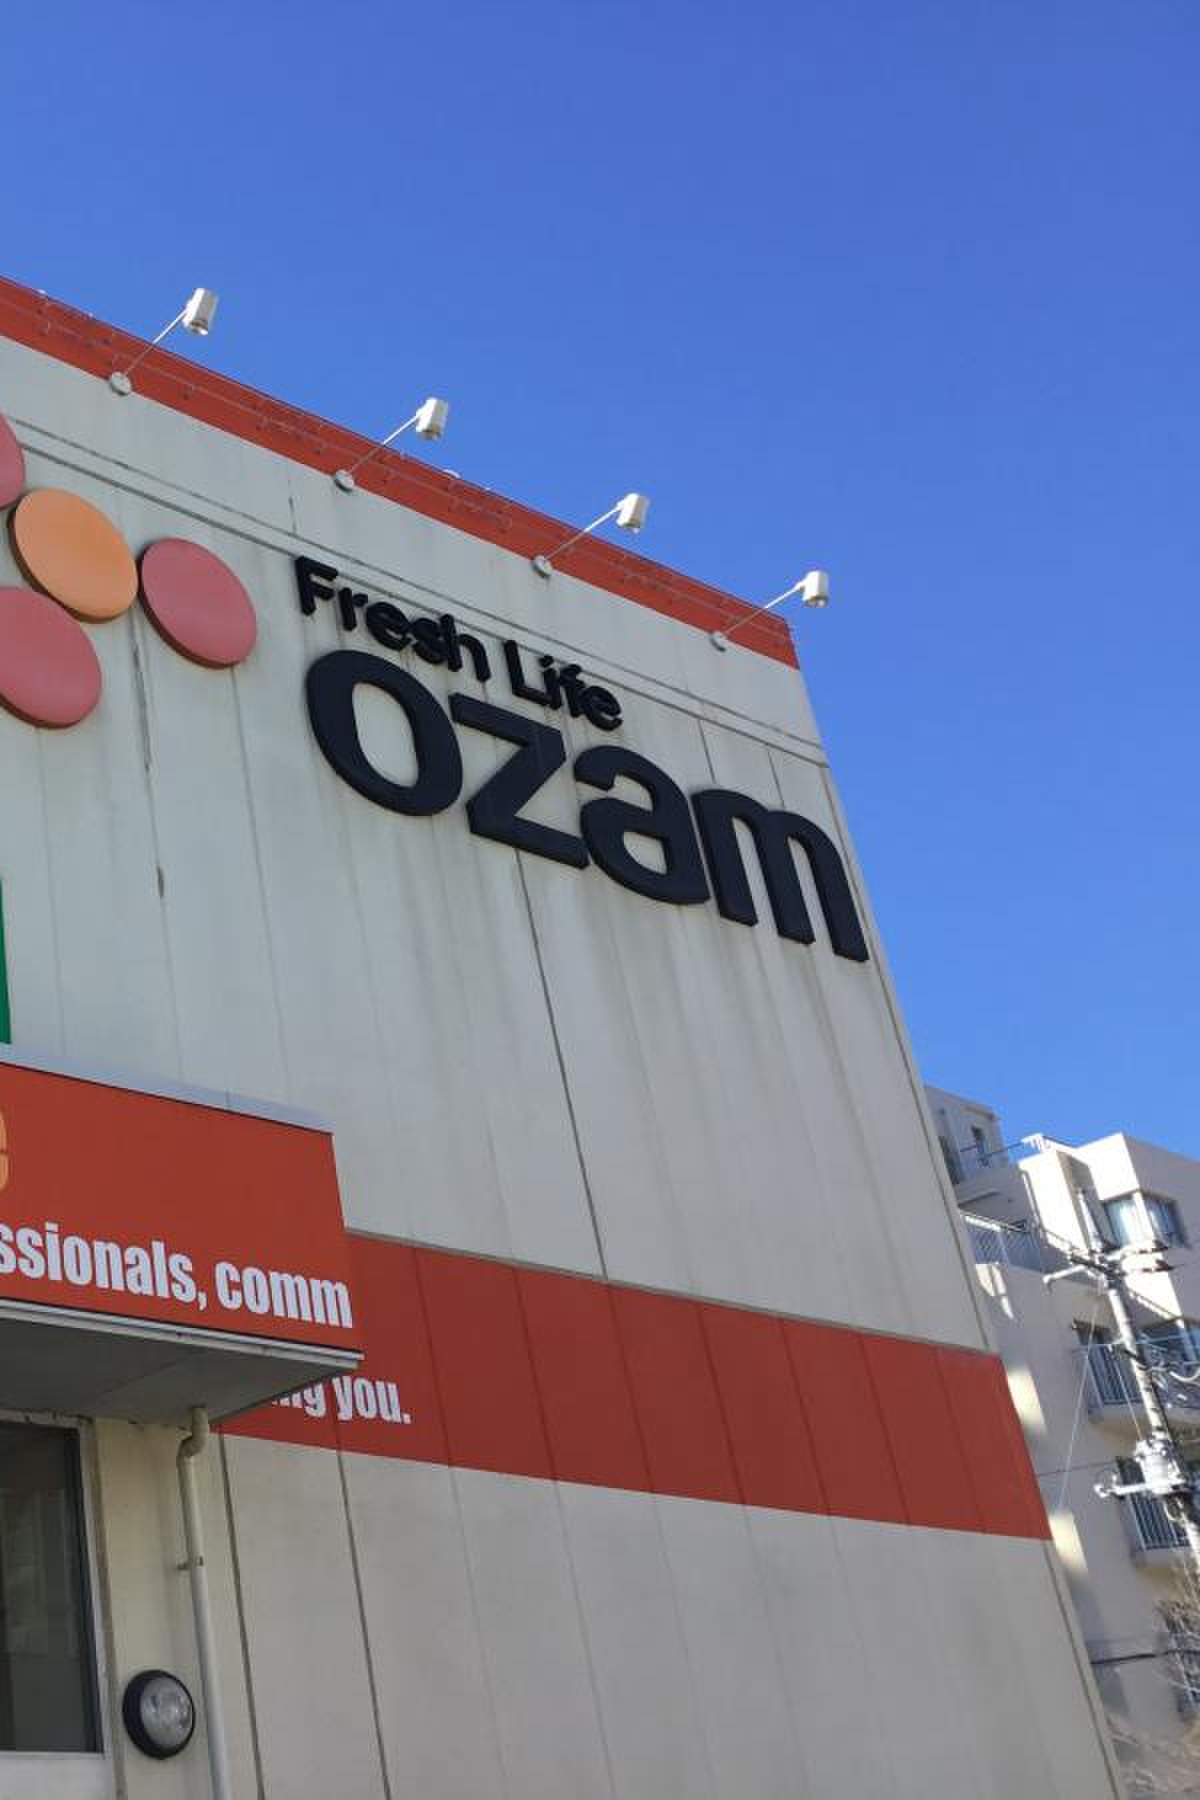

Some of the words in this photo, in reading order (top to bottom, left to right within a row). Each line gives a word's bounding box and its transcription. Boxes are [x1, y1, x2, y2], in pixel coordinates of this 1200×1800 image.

[294, 555, 491, 681] Fresh
[503, 639, 623, 731] Life
[214, 1262, 353, 1329] comm
[332, 1376, 412, 1424] you.
